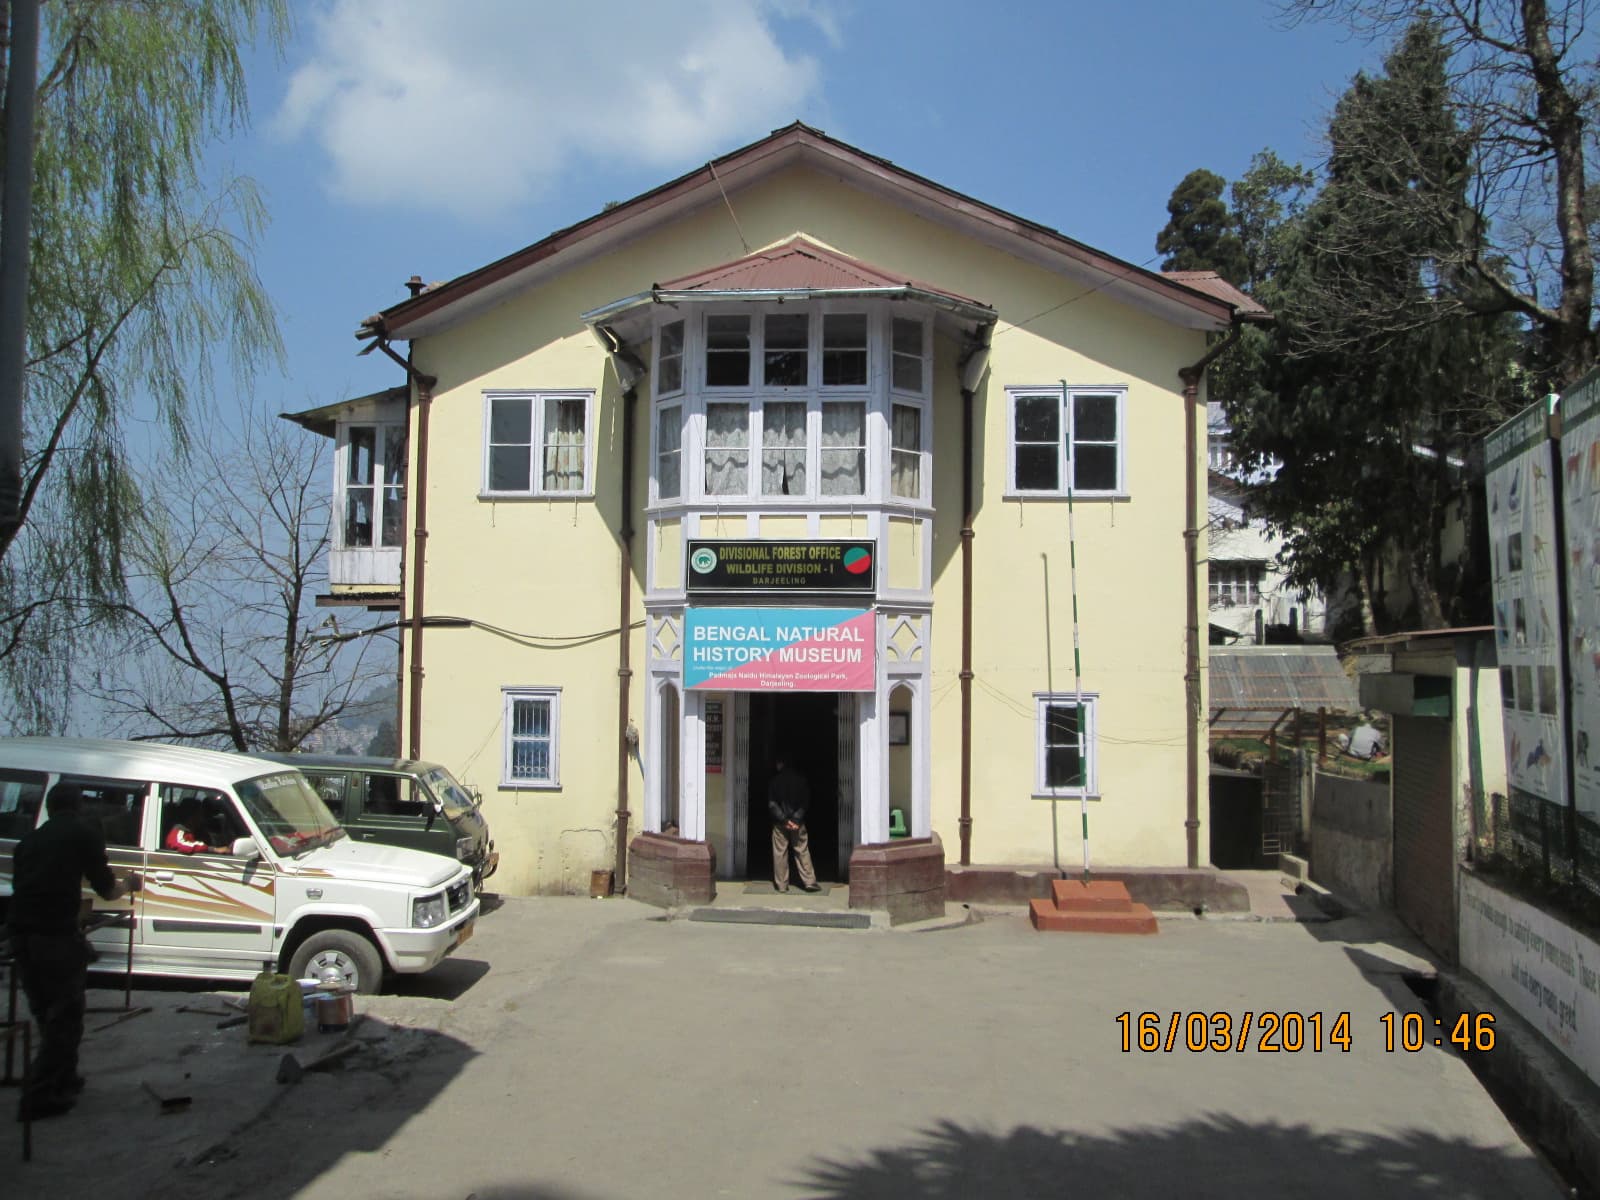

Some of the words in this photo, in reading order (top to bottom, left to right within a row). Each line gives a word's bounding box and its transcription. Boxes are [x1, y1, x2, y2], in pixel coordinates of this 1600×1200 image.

[719, 546, 770, 560] DIVISIONAL
[772, 546, 807, 560] FOREST
[809, 546, 841, 560] OFFICE
[726, 563, 774, 574] WILDLIFE
[776, 563, 821, 574] DIVISION
[752, 577, 806, 585] DARJEELING
[693, 626, 771, 641] BENGAL
[776, 627, 865, 642] NATURAL
[693, 647, 773, 662] HISTORY
[779, 648, 862, 663] MUSEUM
[709, 671, 737, 680] Padmaja
[738, 671, 758, 680] Naidu
[795, 673, 830, 681] Zoological
